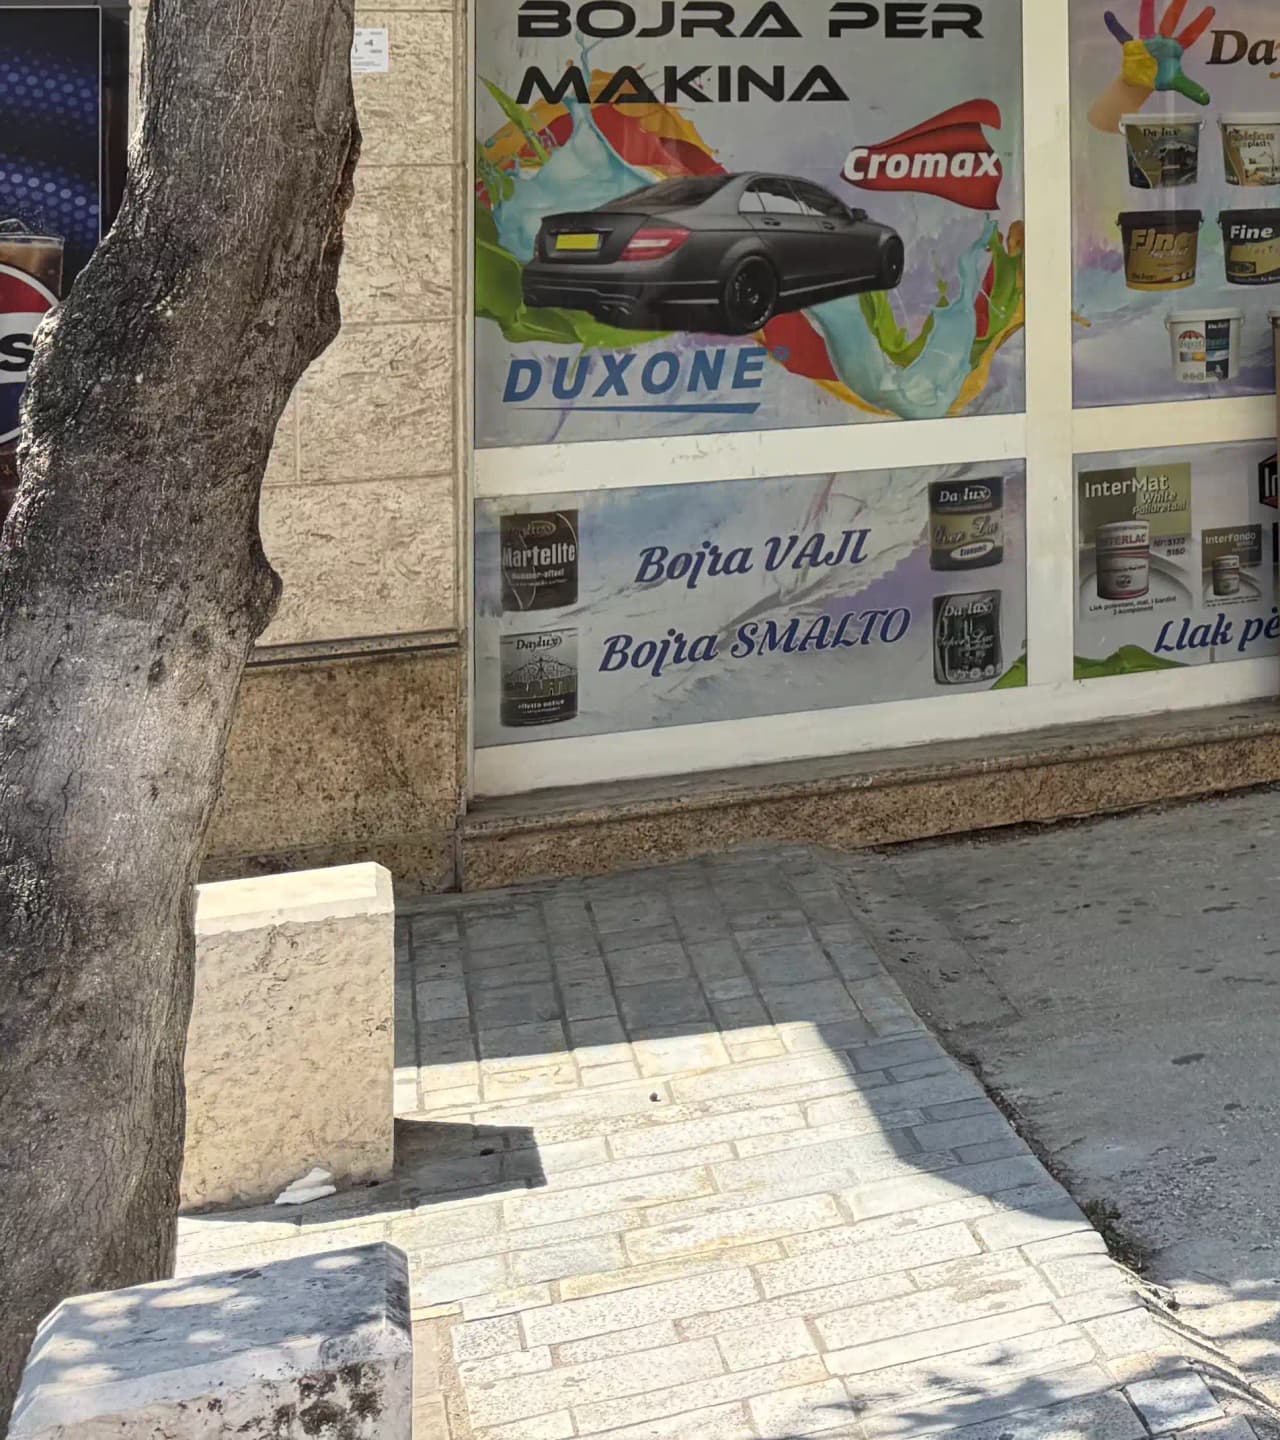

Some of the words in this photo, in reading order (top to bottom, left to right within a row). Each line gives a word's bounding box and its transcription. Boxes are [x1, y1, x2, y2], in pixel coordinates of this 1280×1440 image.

[517, 0, 803, 40] BOJRA
[515, 64, 850, 105] MAKINA
[844, 147, 1000, 181] Cromax
[1230, 224, 1273, 240] Fine
[502, 347, 770, 403] DUXONE
[1085, 474, 1169, 498] InterMat
[635, 540, 753, 589] Bojra
[764, 528, 871, 571] VAJI
[599, 627, 719, 677] Bojra
[730, 606, 911, 659] SMALTO
[1154, 613, 1233, 653] Llak
